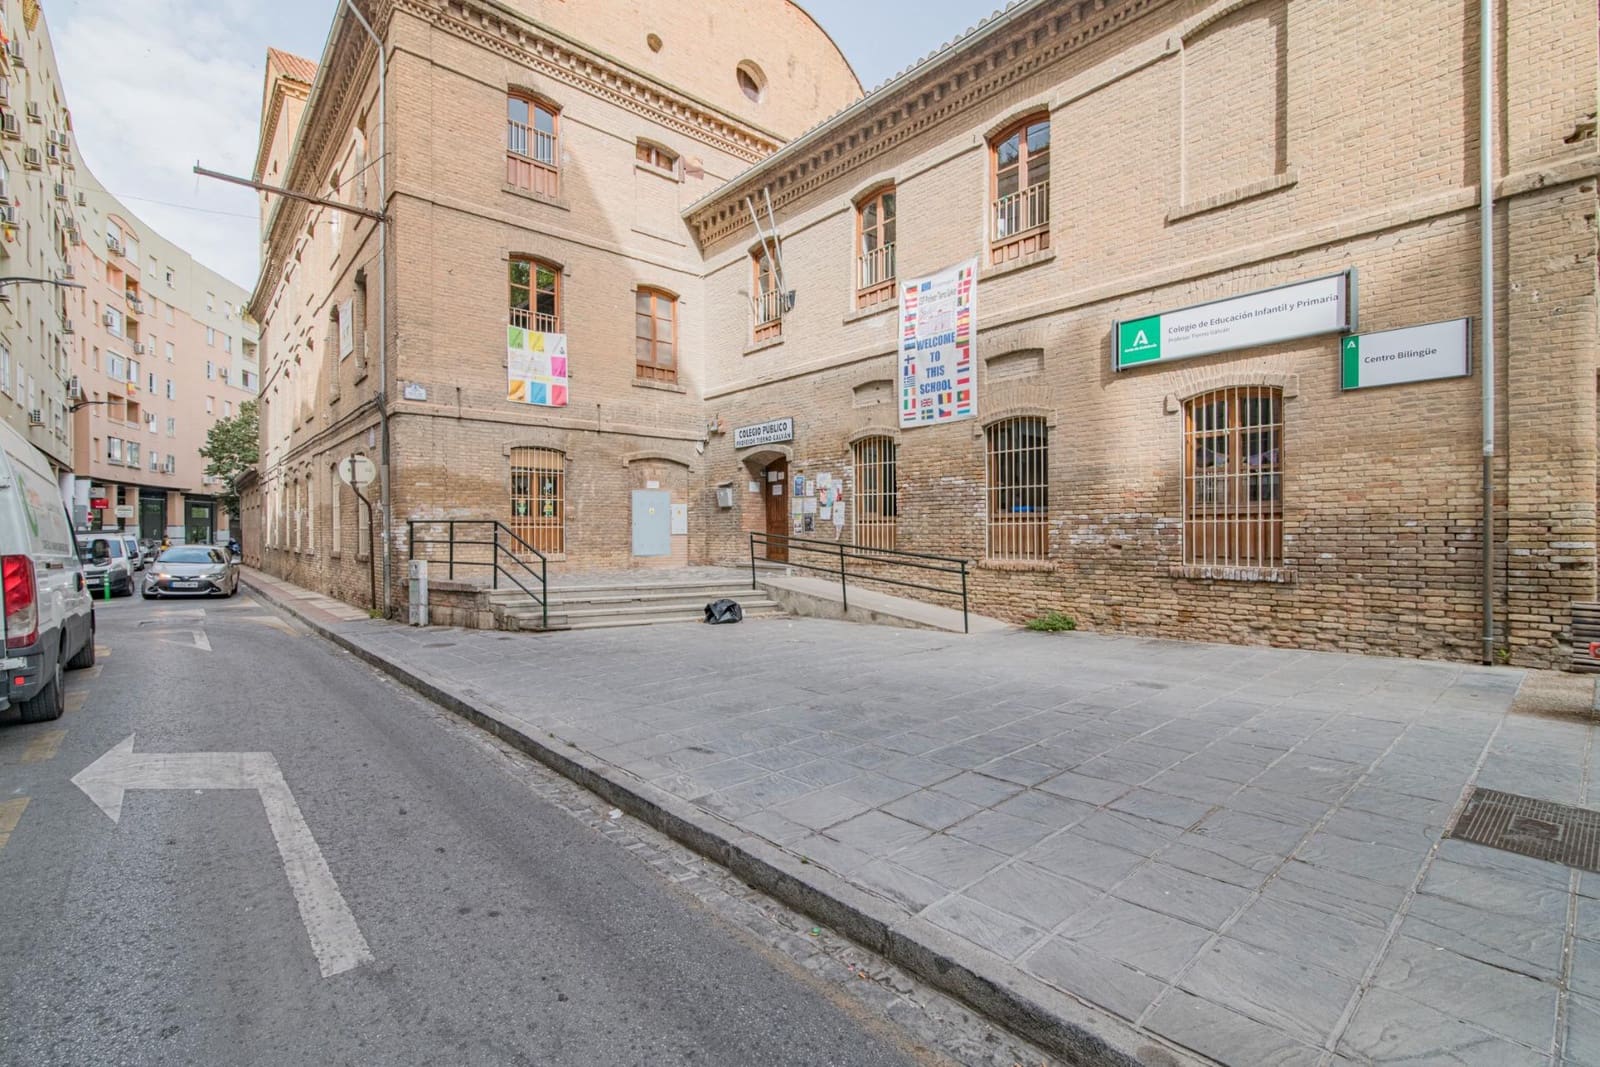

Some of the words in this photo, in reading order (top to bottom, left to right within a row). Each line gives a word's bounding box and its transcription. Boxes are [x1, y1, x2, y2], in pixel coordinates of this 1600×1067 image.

[1168, 323, 1197, 334] Colegio
[1198, 320, 1209, 329] de
[1210, 311, 1253, 326] Educación
[1255, 305, 1288, 317] Infantil
[1288, 303, 1295, 312] y
[1296, 294, 1339, 308] Primaria
[916, 332, 956, 351] WELCOME
[930, 350, 941, 362] TO
[1364, 354, 1396, 364] Centro
[1397, 347, 1437, 359] Bilingüe
[926, 365, 945, 378] THIS
[920, 379, 952, 395] SCHOOL
[739, 427, 761, 439] COLEGIO
